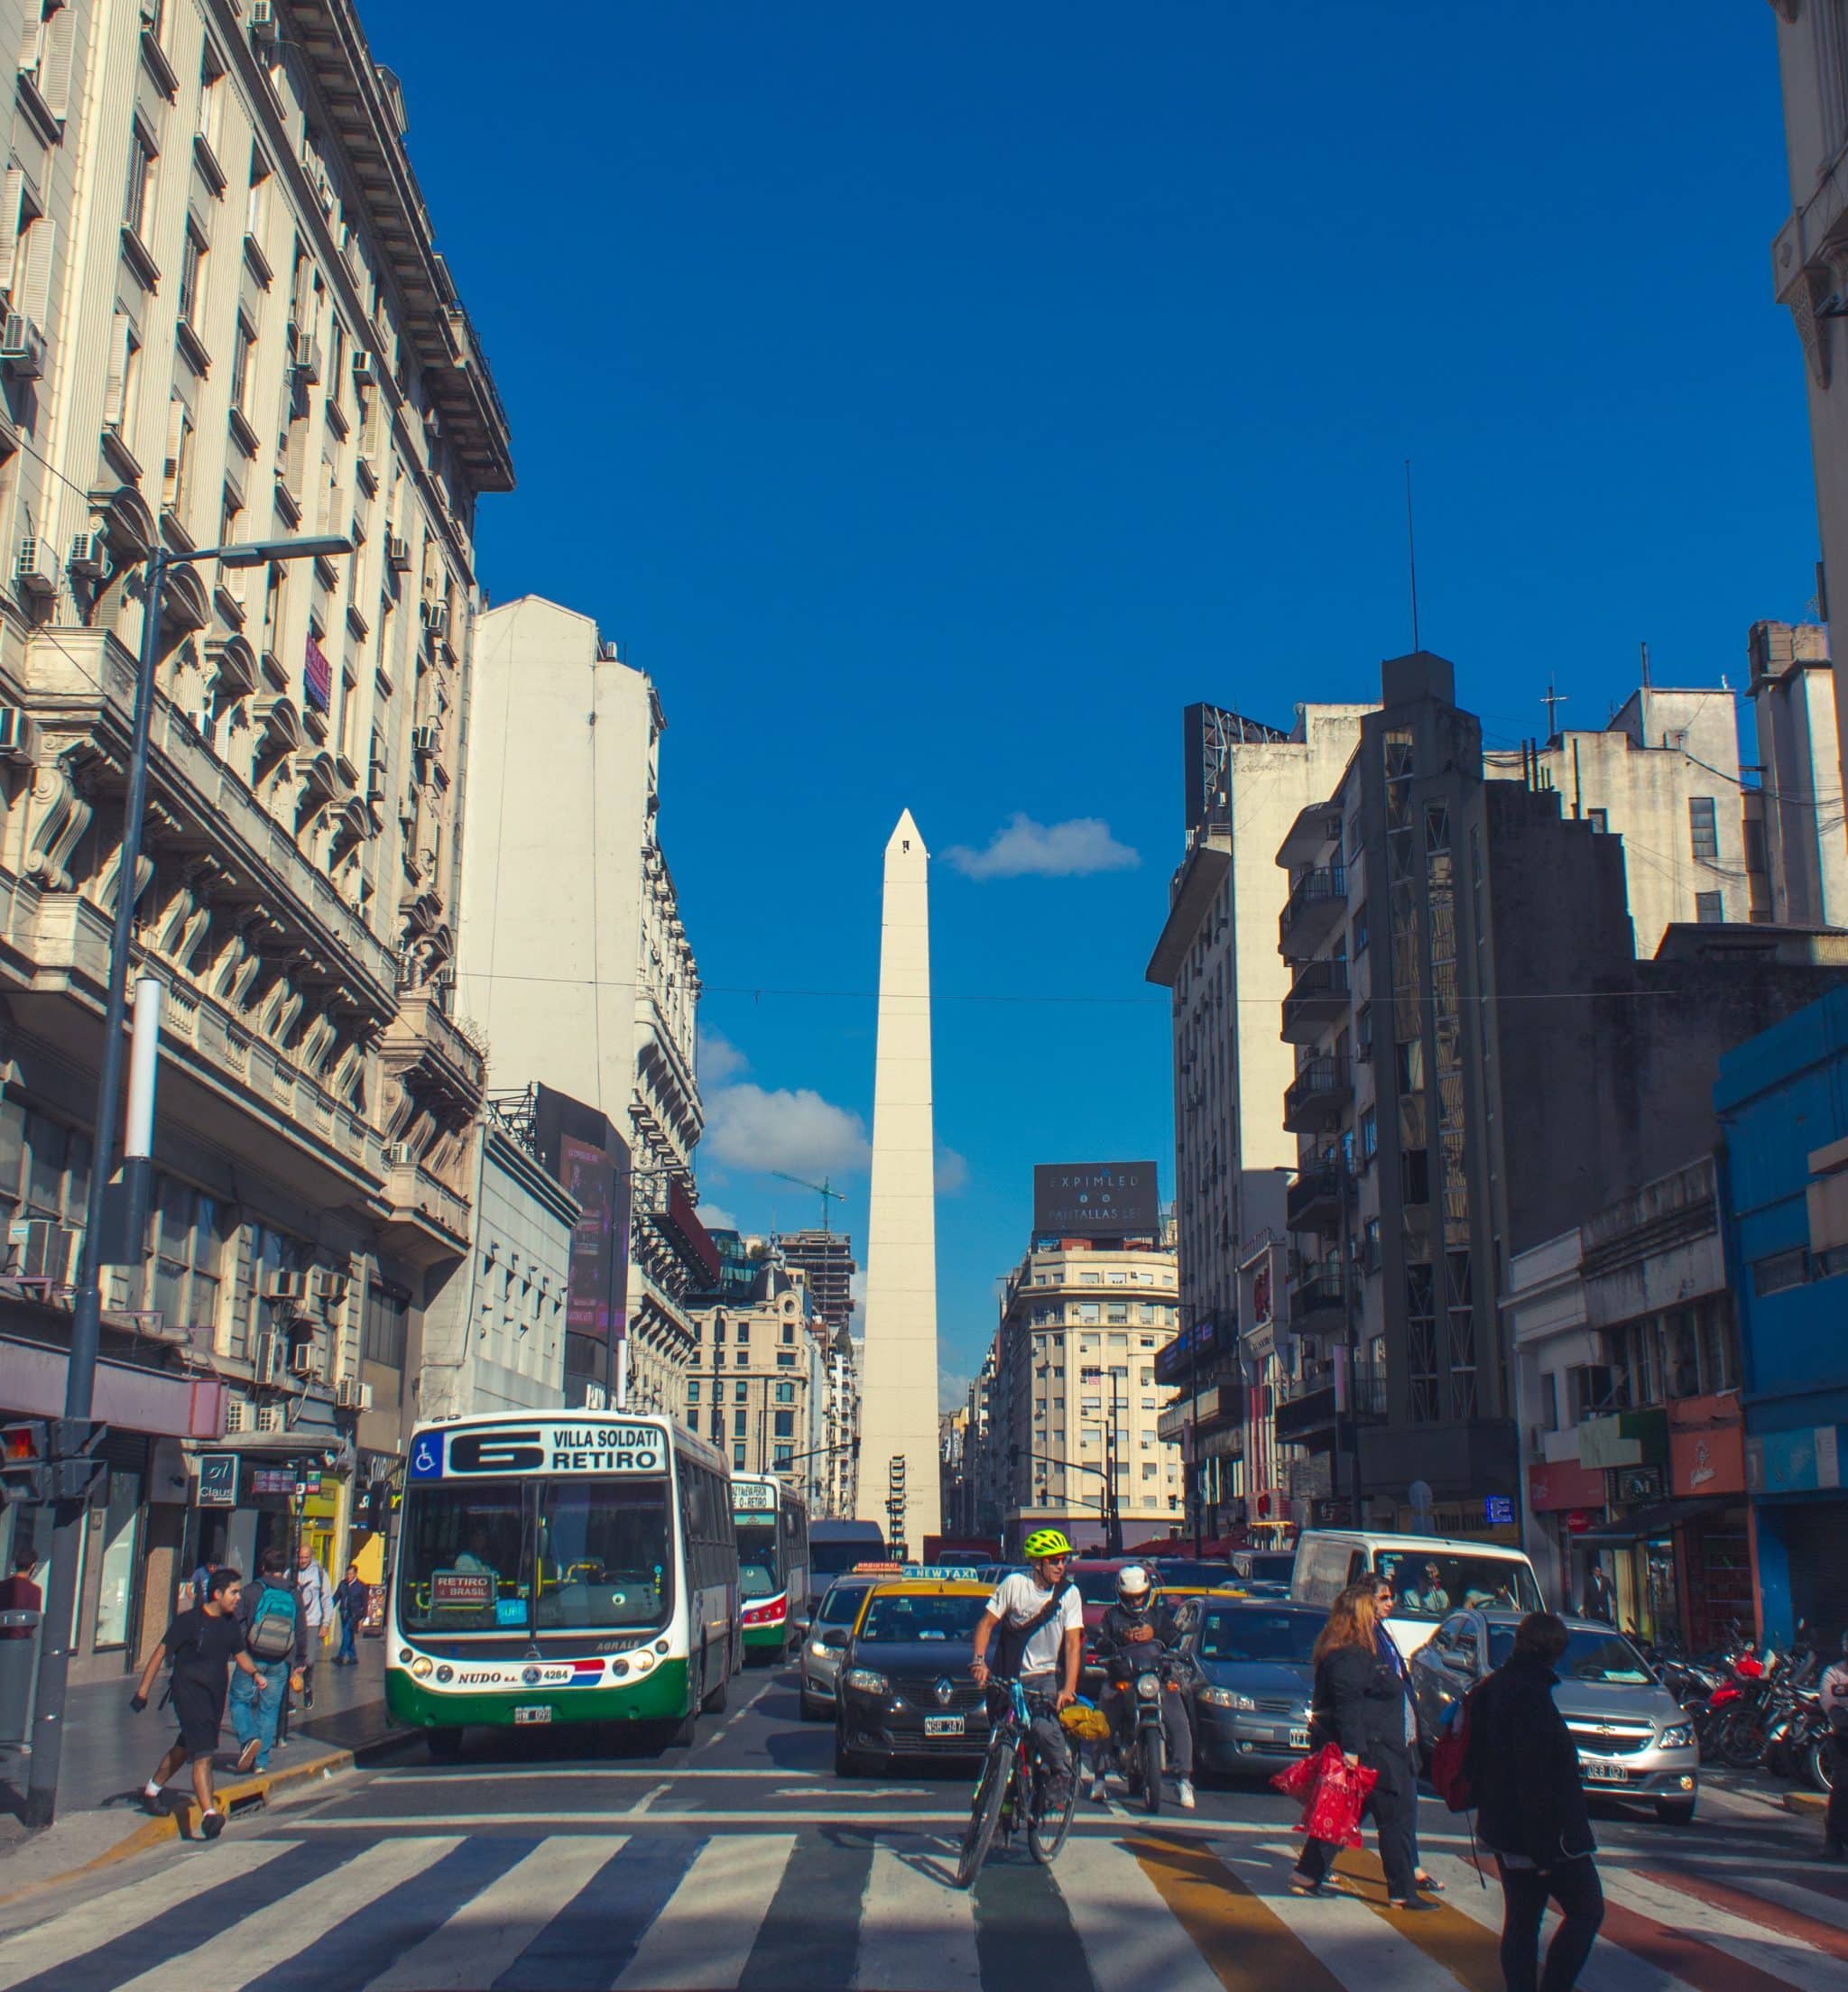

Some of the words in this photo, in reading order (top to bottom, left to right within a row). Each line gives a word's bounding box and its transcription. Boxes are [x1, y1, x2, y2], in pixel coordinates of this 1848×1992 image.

[553, 1431, 593, 1448] VILLA
[597, 1429, 658, 1447] SOLDATI
[449, 1431, 544, 1473] 6
[552, 1451, 657, 1470] RETIRO
[917, 1569, 941, 1578] NEW
[945, 1570, 974, 1579] TAXI
[438, 1577, 488, 1586] RETIRO
[450, 1588, 486, 1596] BRASIL
[457, 1672, 502, 1684] NUDO
